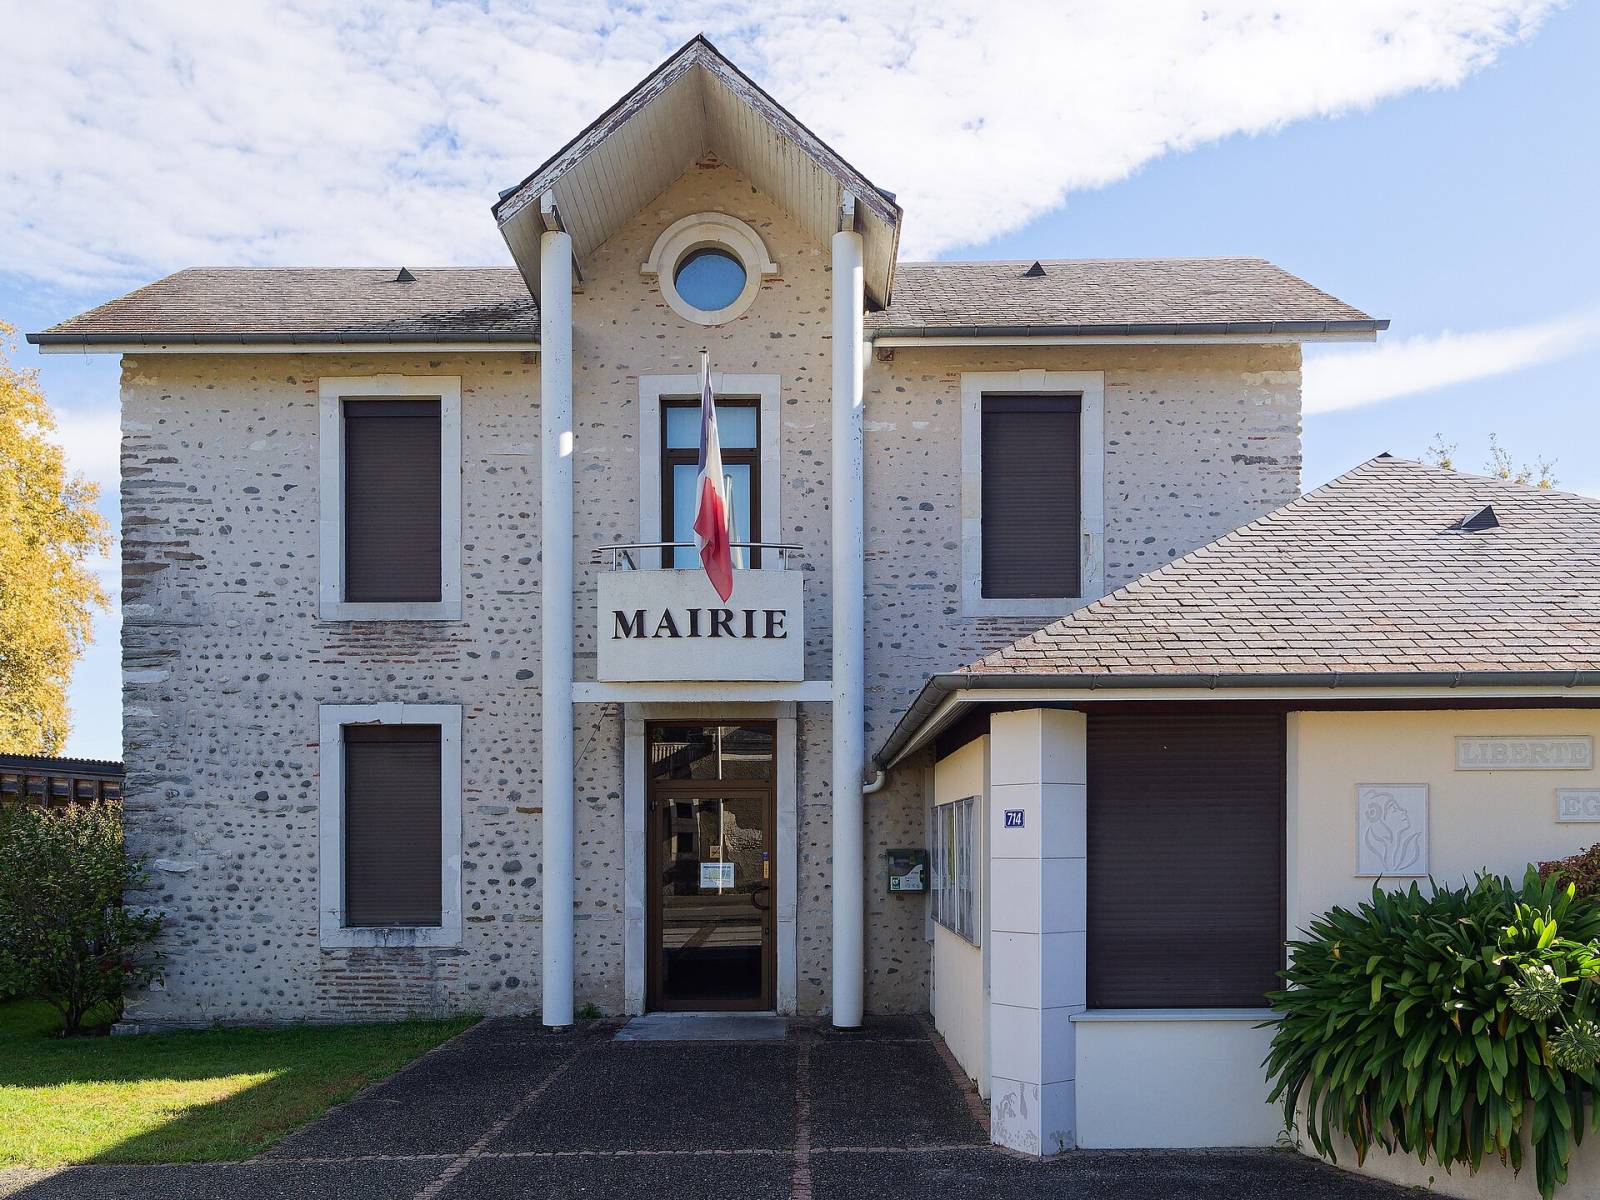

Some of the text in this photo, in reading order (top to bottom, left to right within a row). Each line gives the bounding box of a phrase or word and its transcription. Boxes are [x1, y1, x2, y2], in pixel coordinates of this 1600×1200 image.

[611, 607, 788, 640] MAIRIE
[1461, 742, 1588, 764] LIBERTE
[1006, 812, 1022, 826] 714
